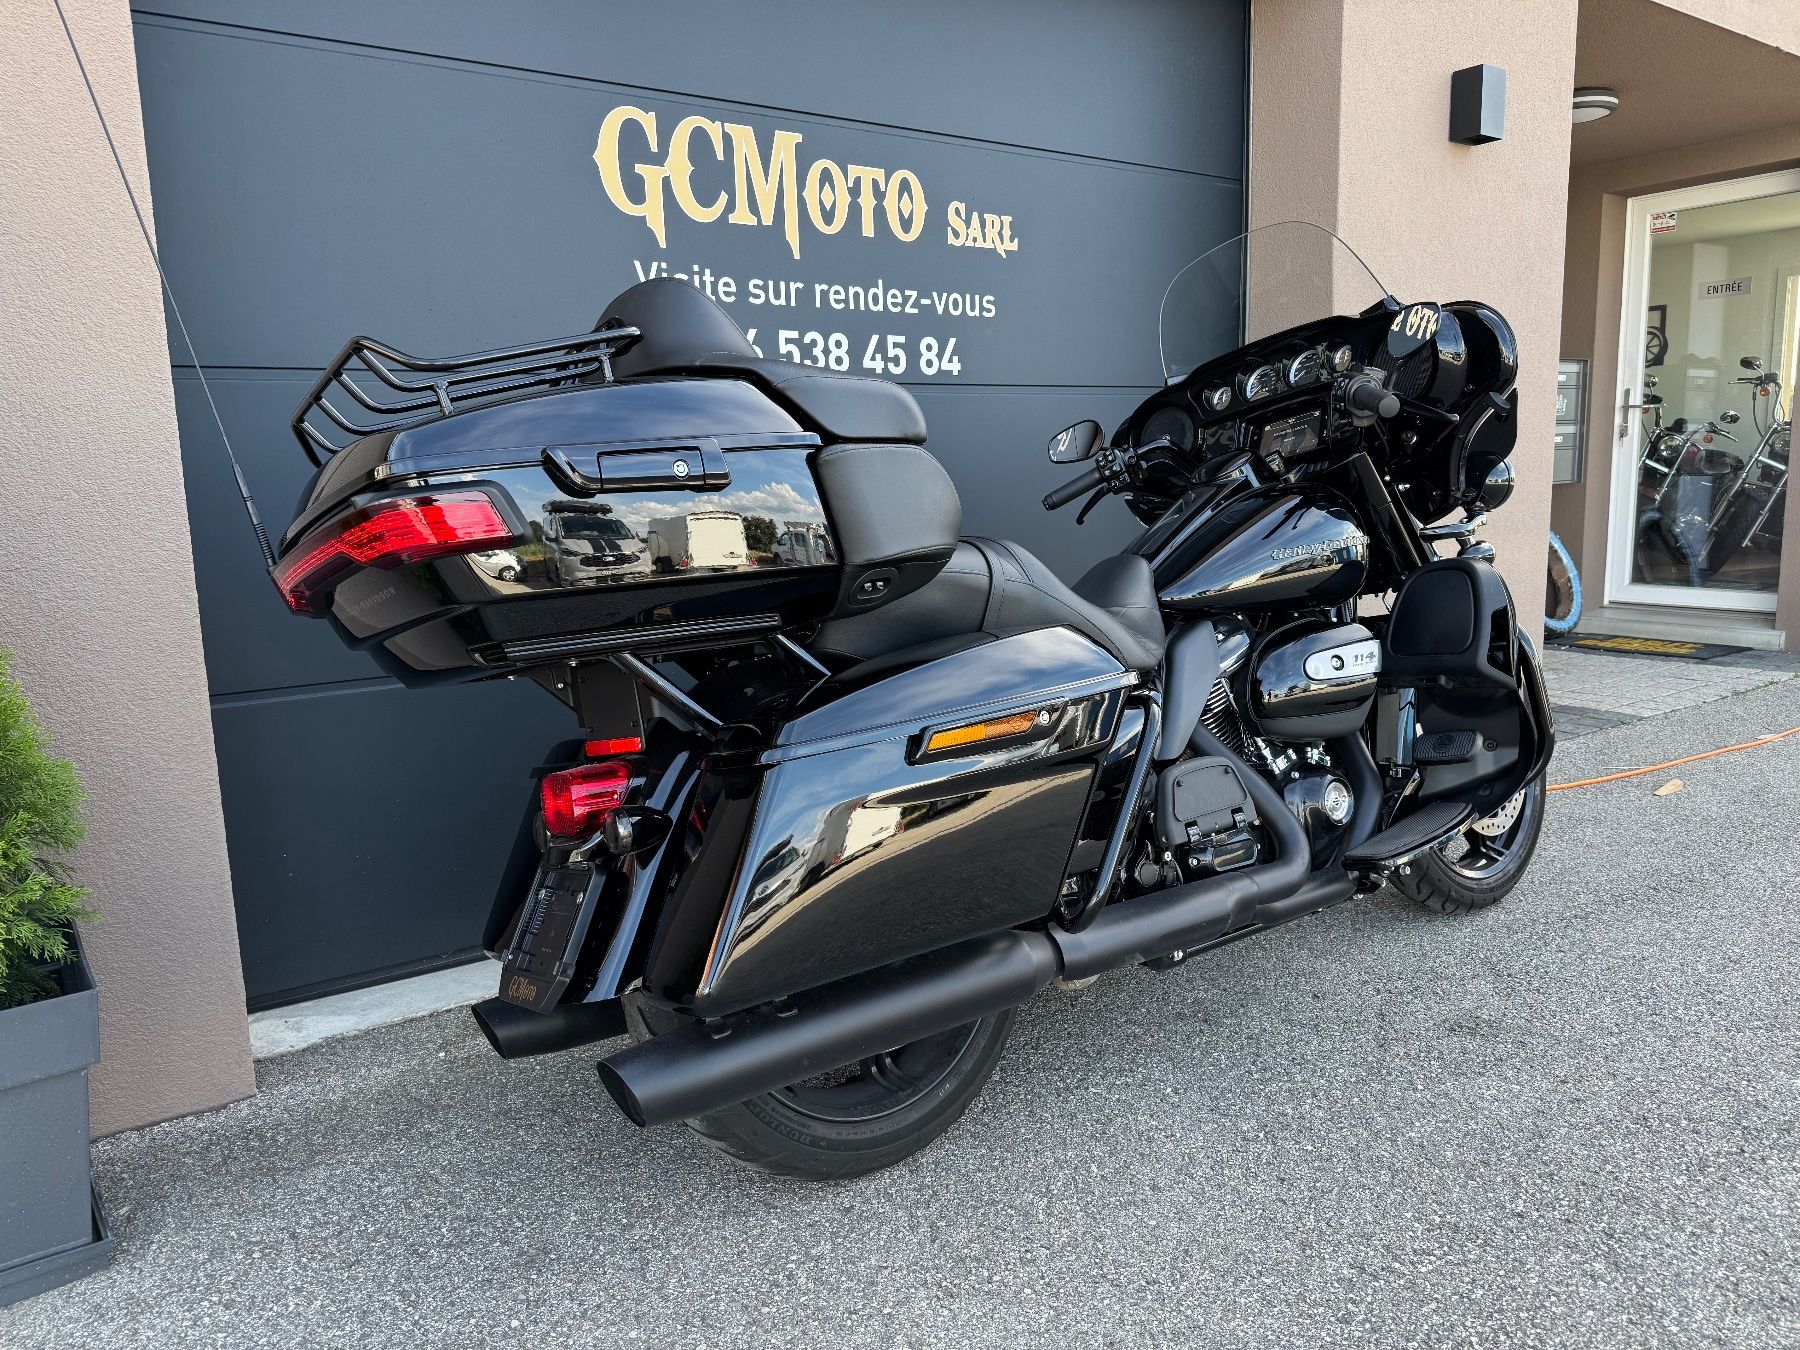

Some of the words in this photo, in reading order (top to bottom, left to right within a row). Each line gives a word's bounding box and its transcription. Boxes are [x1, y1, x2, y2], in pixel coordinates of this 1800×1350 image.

[633, 259, 737, 303] Vite
[748, 278, 804, 307] sur
[814, 279, 996, 318] rendez-vous
[1706, 280, 1743, 295] ENTRÉE
[778, 329, 850, 374] 538
[862, 334, 907, 375] 45
[919, 336, 962, 376] 84
[1353, 651, 1377, 663] 114
